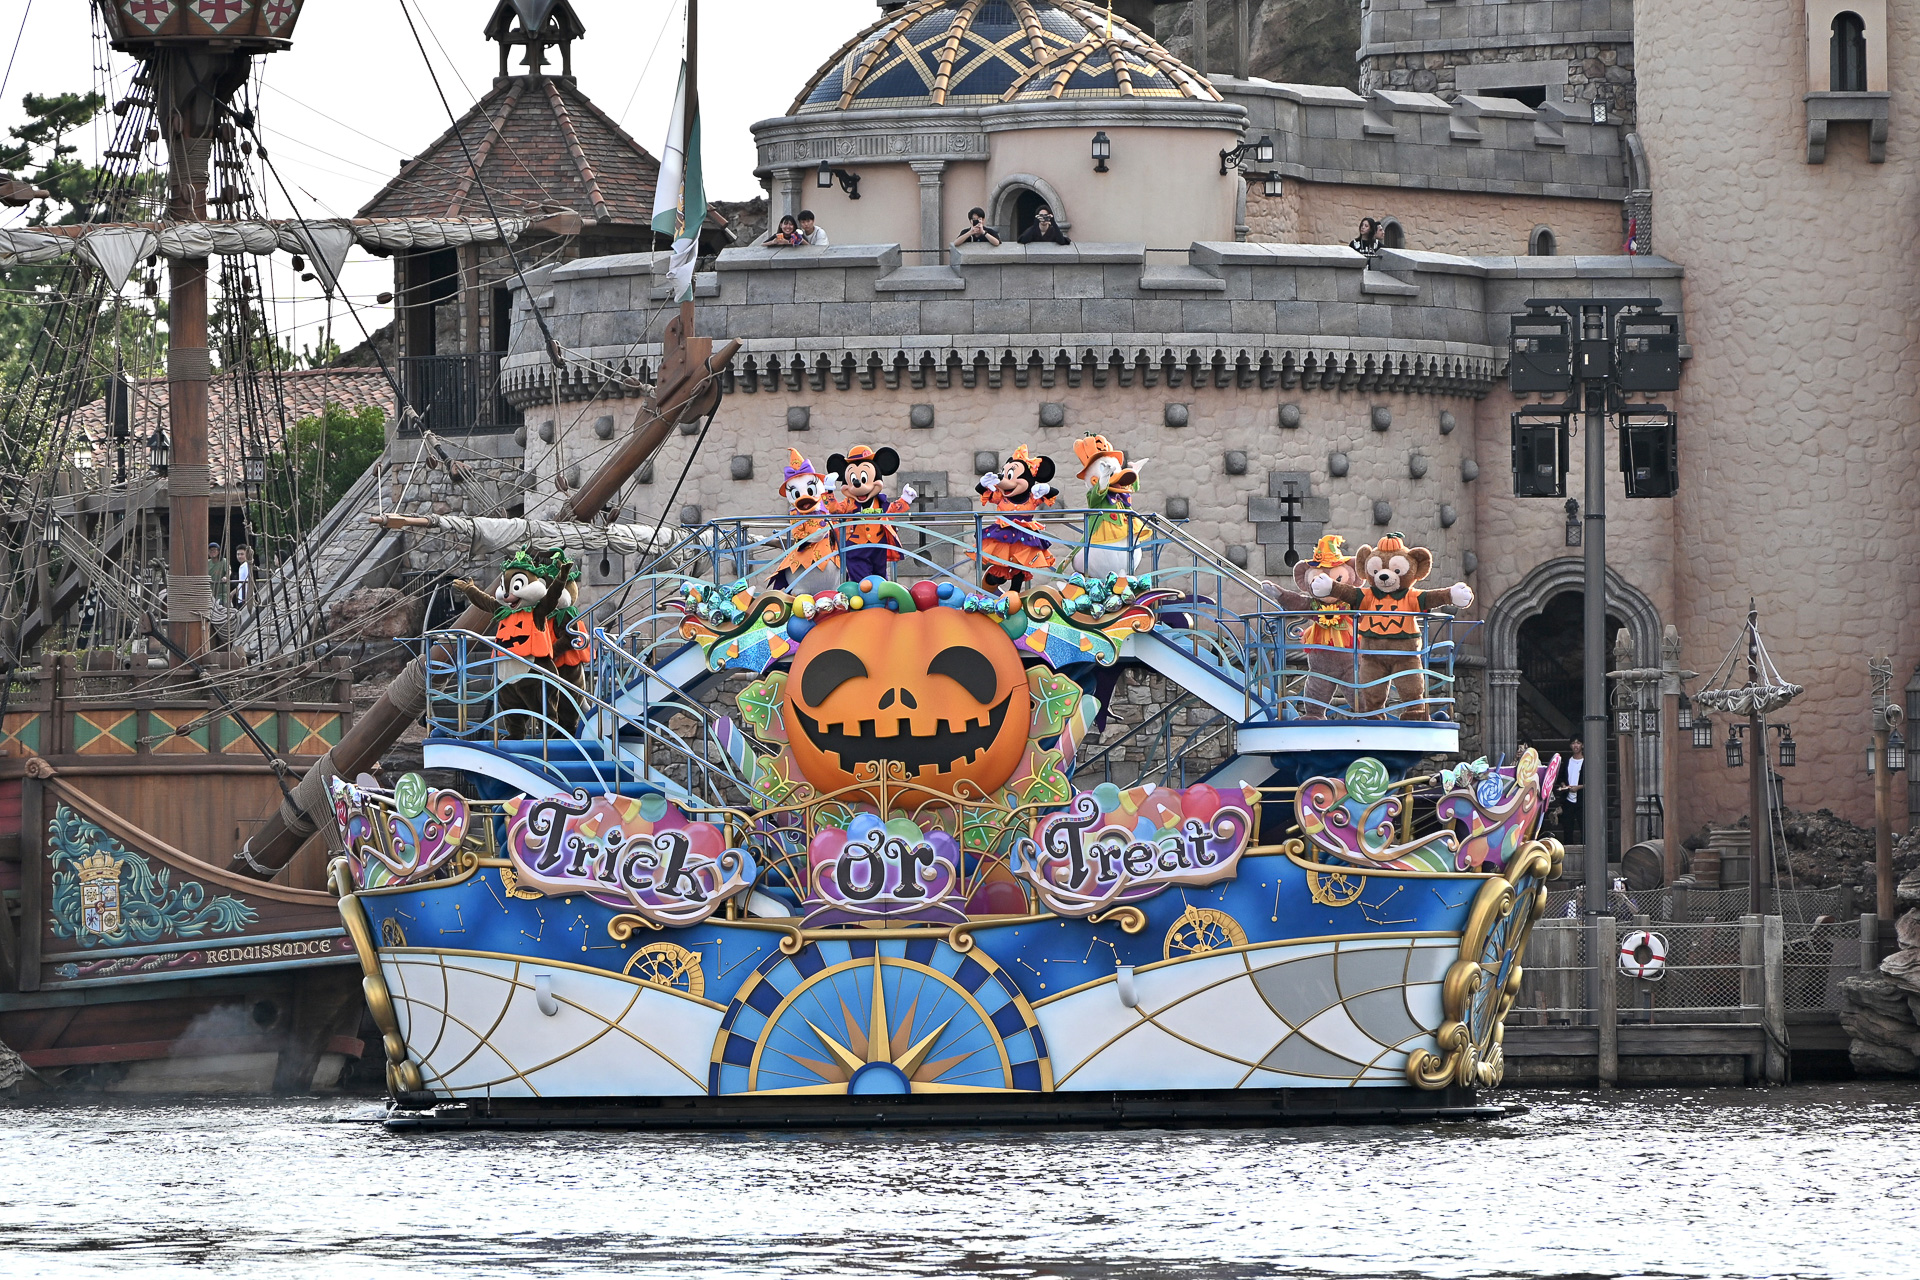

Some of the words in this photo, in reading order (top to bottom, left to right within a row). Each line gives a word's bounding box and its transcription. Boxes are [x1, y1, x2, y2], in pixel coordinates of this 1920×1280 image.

[528, 787, 716, 902] Trick
[837, 829, 934, 901] or
[1045, 797, 1216, 889] Treat
